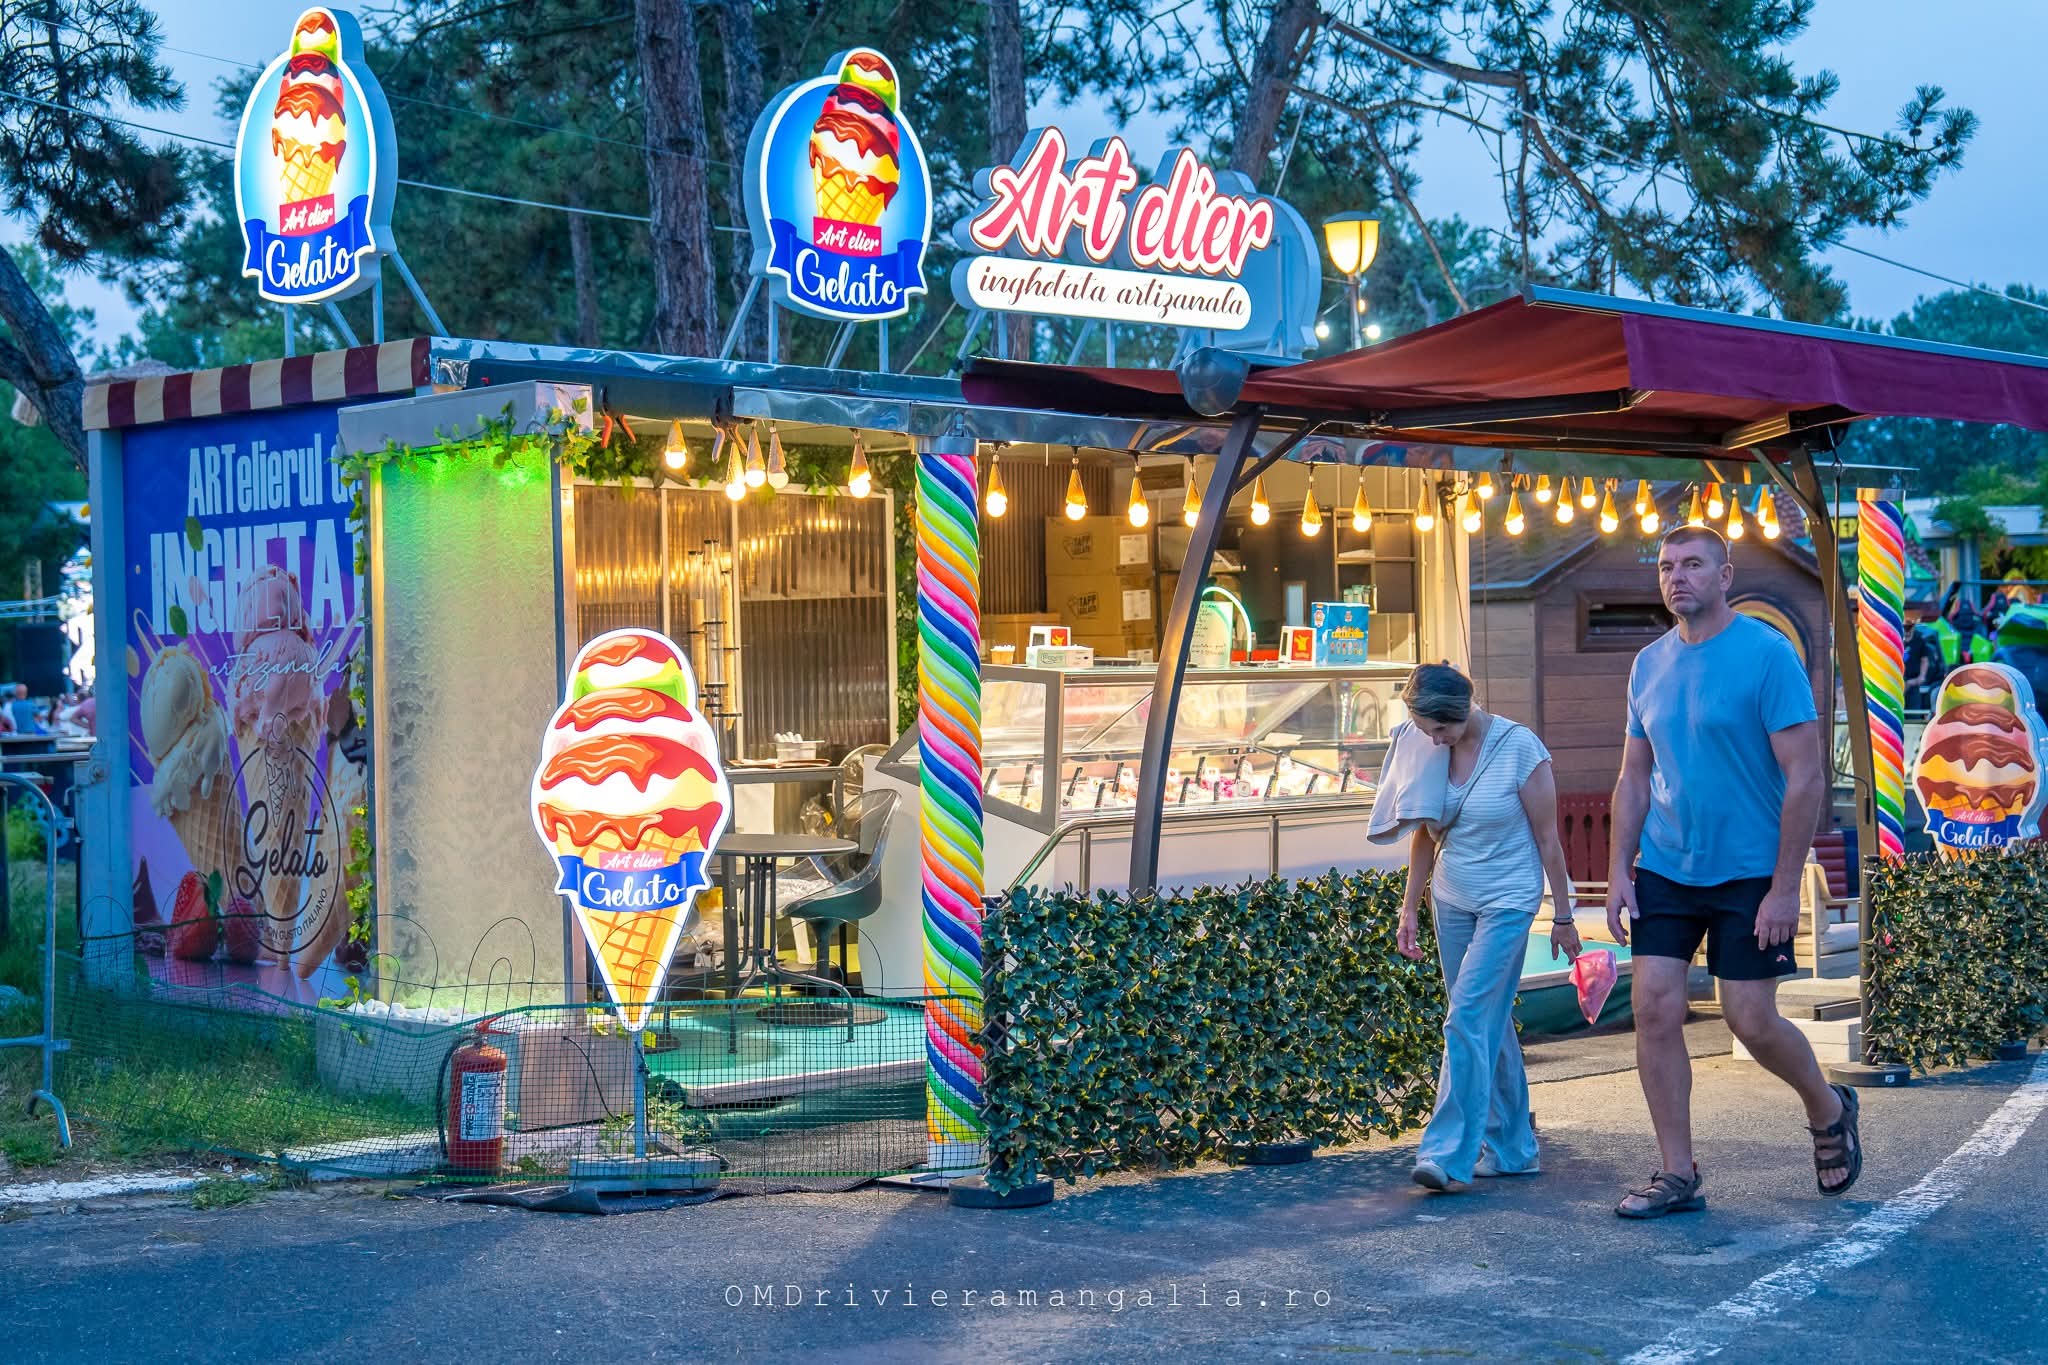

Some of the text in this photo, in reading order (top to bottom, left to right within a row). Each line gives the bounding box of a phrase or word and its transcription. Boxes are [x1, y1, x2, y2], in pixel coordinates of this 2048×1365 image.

[282, 203, 334, 232] Art elier
[974, 130, 1271, 272] Art elier
[816, 224, 880, 252] Art elier
[265, 235, 353, 290] Gelato
[796, 248, 903, 307] Gelato
[979, 266, 1246, 319] inghetata artizanala
[187, 433, 323, 517] ARTelierul
[210, 639, 352, 692] artizanala
[1940, 820, 2005, 847] Gelato
[1956, 810, 1994, 822] Art elier
[235, 800, 329, 900] Gelato
[604, 853, 663, 870] Art elier
[302, 888, 329, 932] ITALIANO
[582, 871, 685, 908] Gelato
